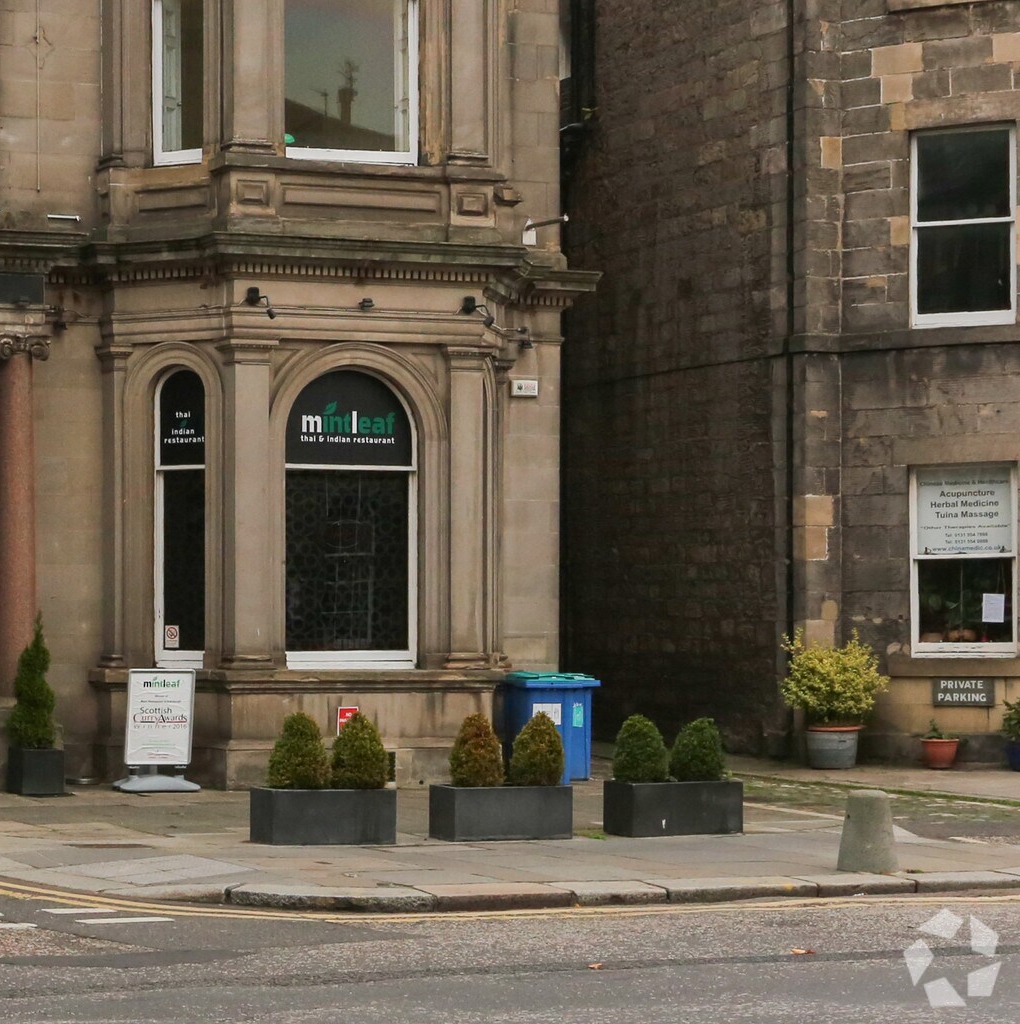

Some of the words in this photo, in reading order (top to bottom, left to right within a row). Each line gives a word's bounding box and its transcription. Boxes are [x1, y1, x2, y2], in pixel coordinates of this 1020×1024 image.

[302, 403, 396, 434] mintleaf
[164, 436, 205, 444] restaurant
[939, 490, 995, 498] Acupuncture
[930, 500, 958, 508] Herbal
[960, 499, 999, 507] Medicine
[961, 510, 999, 519] Massage
[143, 677, 180, 687] mintleaf
[940, 680, 984, 689] PRIVATE
[937, 693, 987, 702] PARKING
